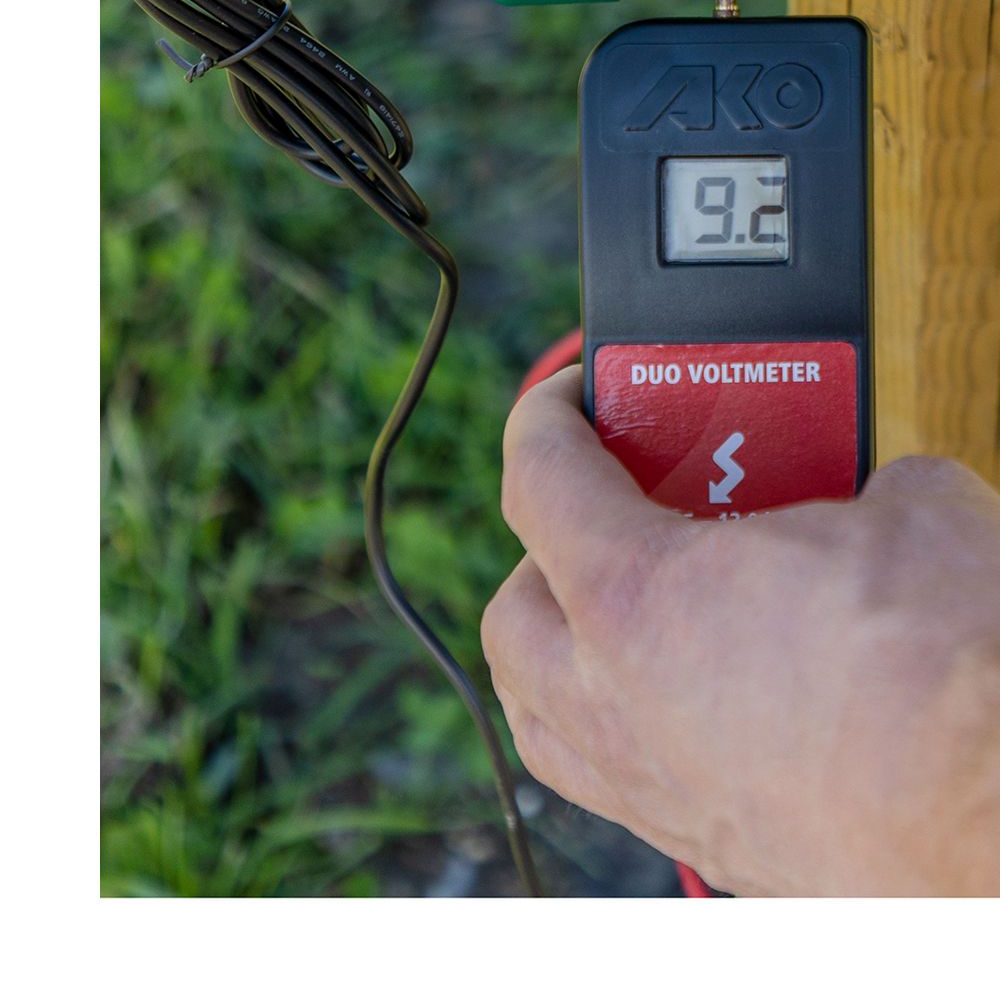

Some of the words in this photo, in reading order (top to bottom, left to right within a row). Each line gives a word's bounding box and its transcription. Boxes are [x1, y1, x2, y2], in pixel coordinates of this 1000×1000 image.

[624, 62, 824, 133] AKO
[694, 176, 787, 245] 9.2
[631, 364, 681, 385] DUO
[688, 362, 821, 385] VOLTMETER
